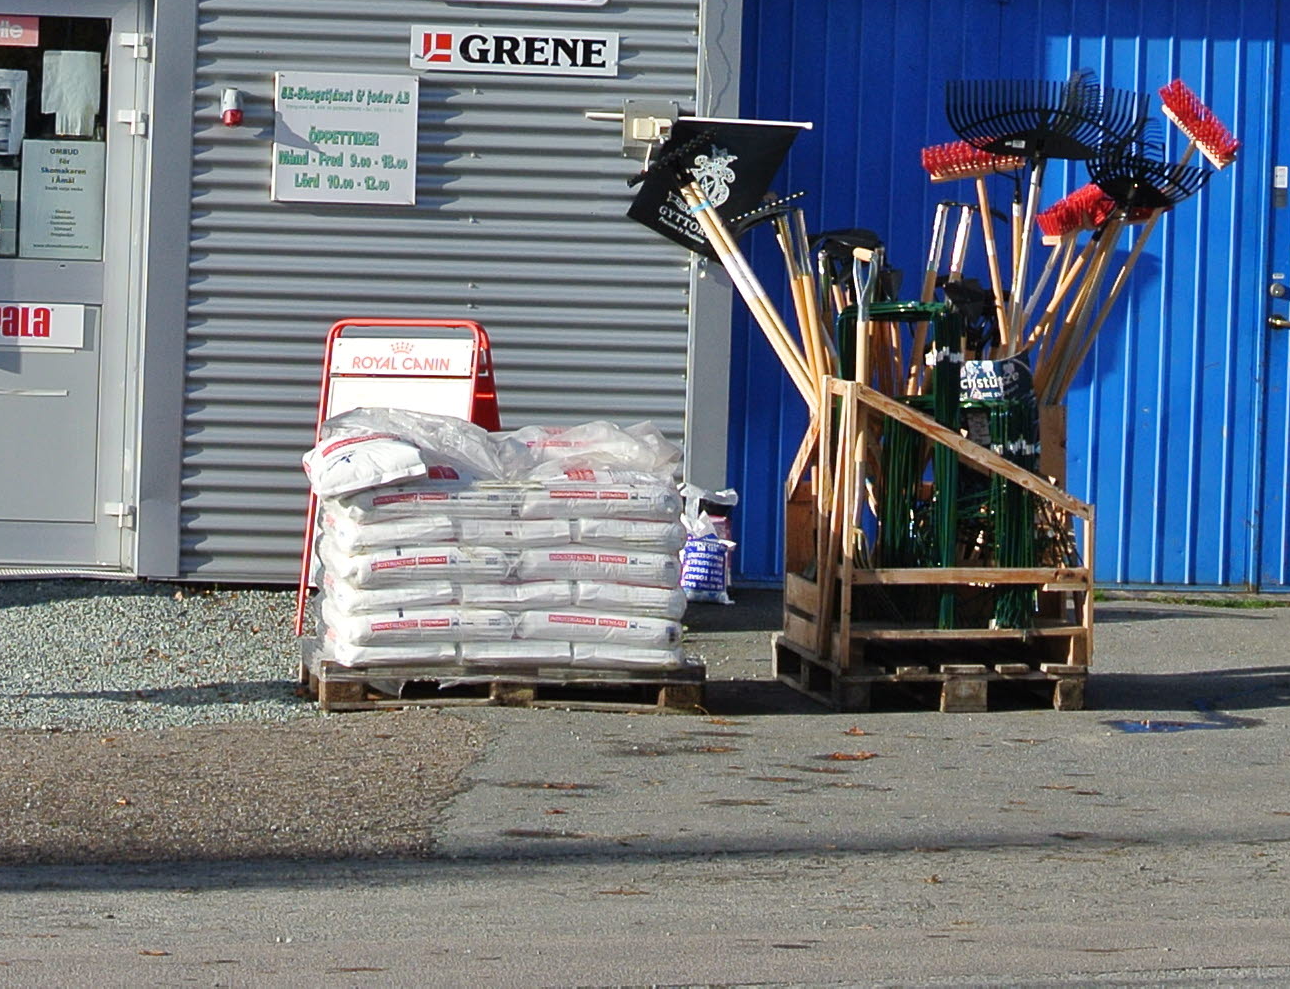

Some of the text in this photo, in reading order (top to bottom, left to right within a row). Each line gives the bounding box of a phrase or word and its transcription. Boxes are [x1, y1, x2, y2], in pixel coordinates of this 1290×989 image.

[458, 34, 608, 68] GRENE
[309, 126, 380, 146] ÖPPETTIDER
[318, 151, 344, 168] Fred
[294, 172, 320, 188] Lörd
[659, 205, 707, 237] GYTTOR
[351, 355, 451, 372] ROYAL CANIN
